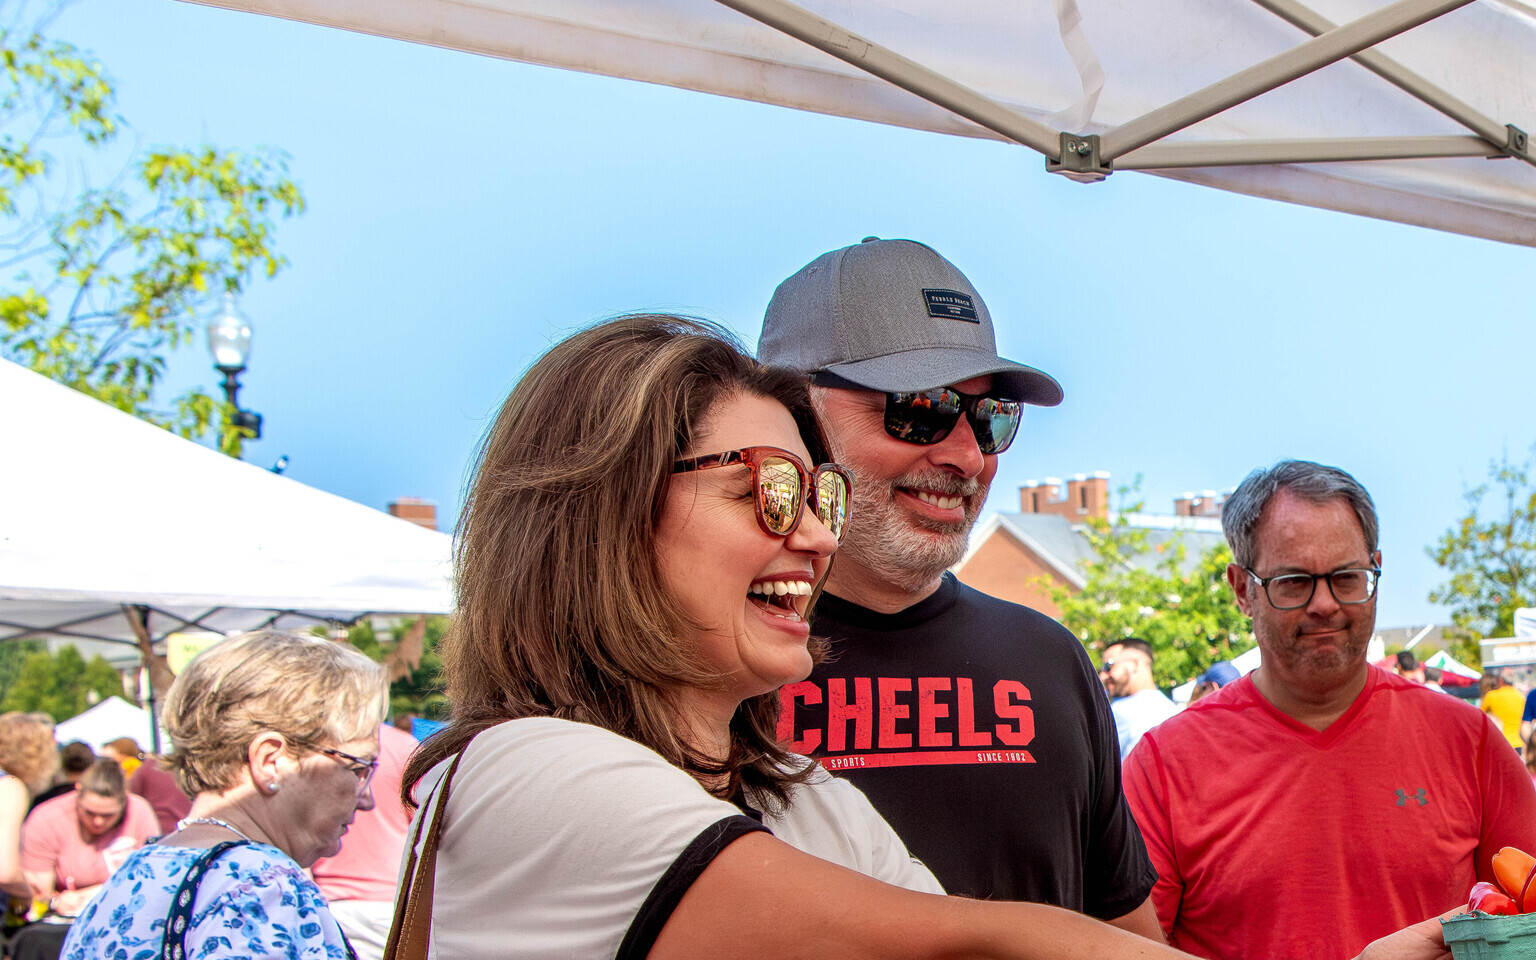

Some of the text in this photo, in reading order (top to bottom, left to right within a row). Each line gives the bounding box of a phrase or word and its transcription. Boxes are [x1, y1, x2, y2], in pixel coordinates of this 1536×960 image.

[776, 677, 1035, 755] CHEELS
[830, 757, 866, 769] SPORTS
[977, 752, 1002, 762] SINCE
